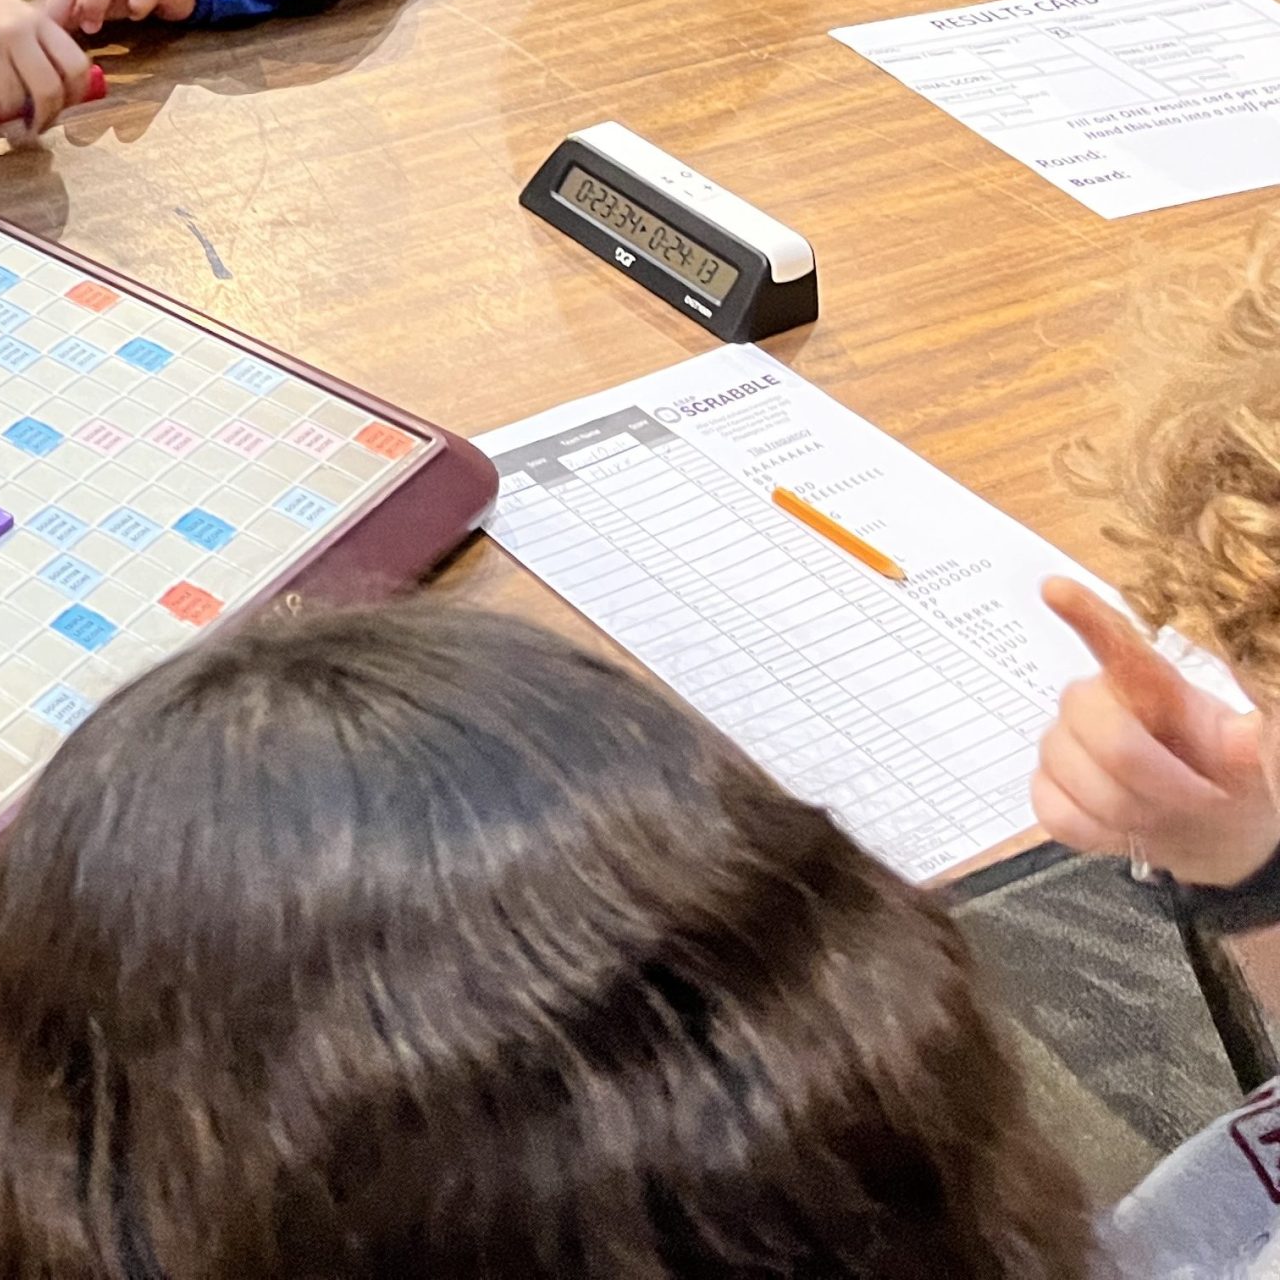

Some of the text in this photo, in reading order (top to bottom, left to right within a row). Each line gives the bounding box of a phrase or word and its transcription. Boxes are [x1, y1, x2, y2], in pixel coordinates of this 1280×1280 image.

[929, 4, 1034, 31] RESULTS
[1066, 117, 1091, 130] Fill
[1093, 114, 1119, 125] out
[1119, 106, 1151, 119] ONE
[1153, 98, 1200, 114] results
[1203, 91, 1233, 105] card
[1236, 87, 1258, 101] per
[1084, 125, 1122, 141] Hand
[1124, 121, 1152, 133] this
[1035, 148, 1107, 169] Round:
[1069, 169, 1132, 189] Board:
[680, 373, 782, 418] SCRABBLE
